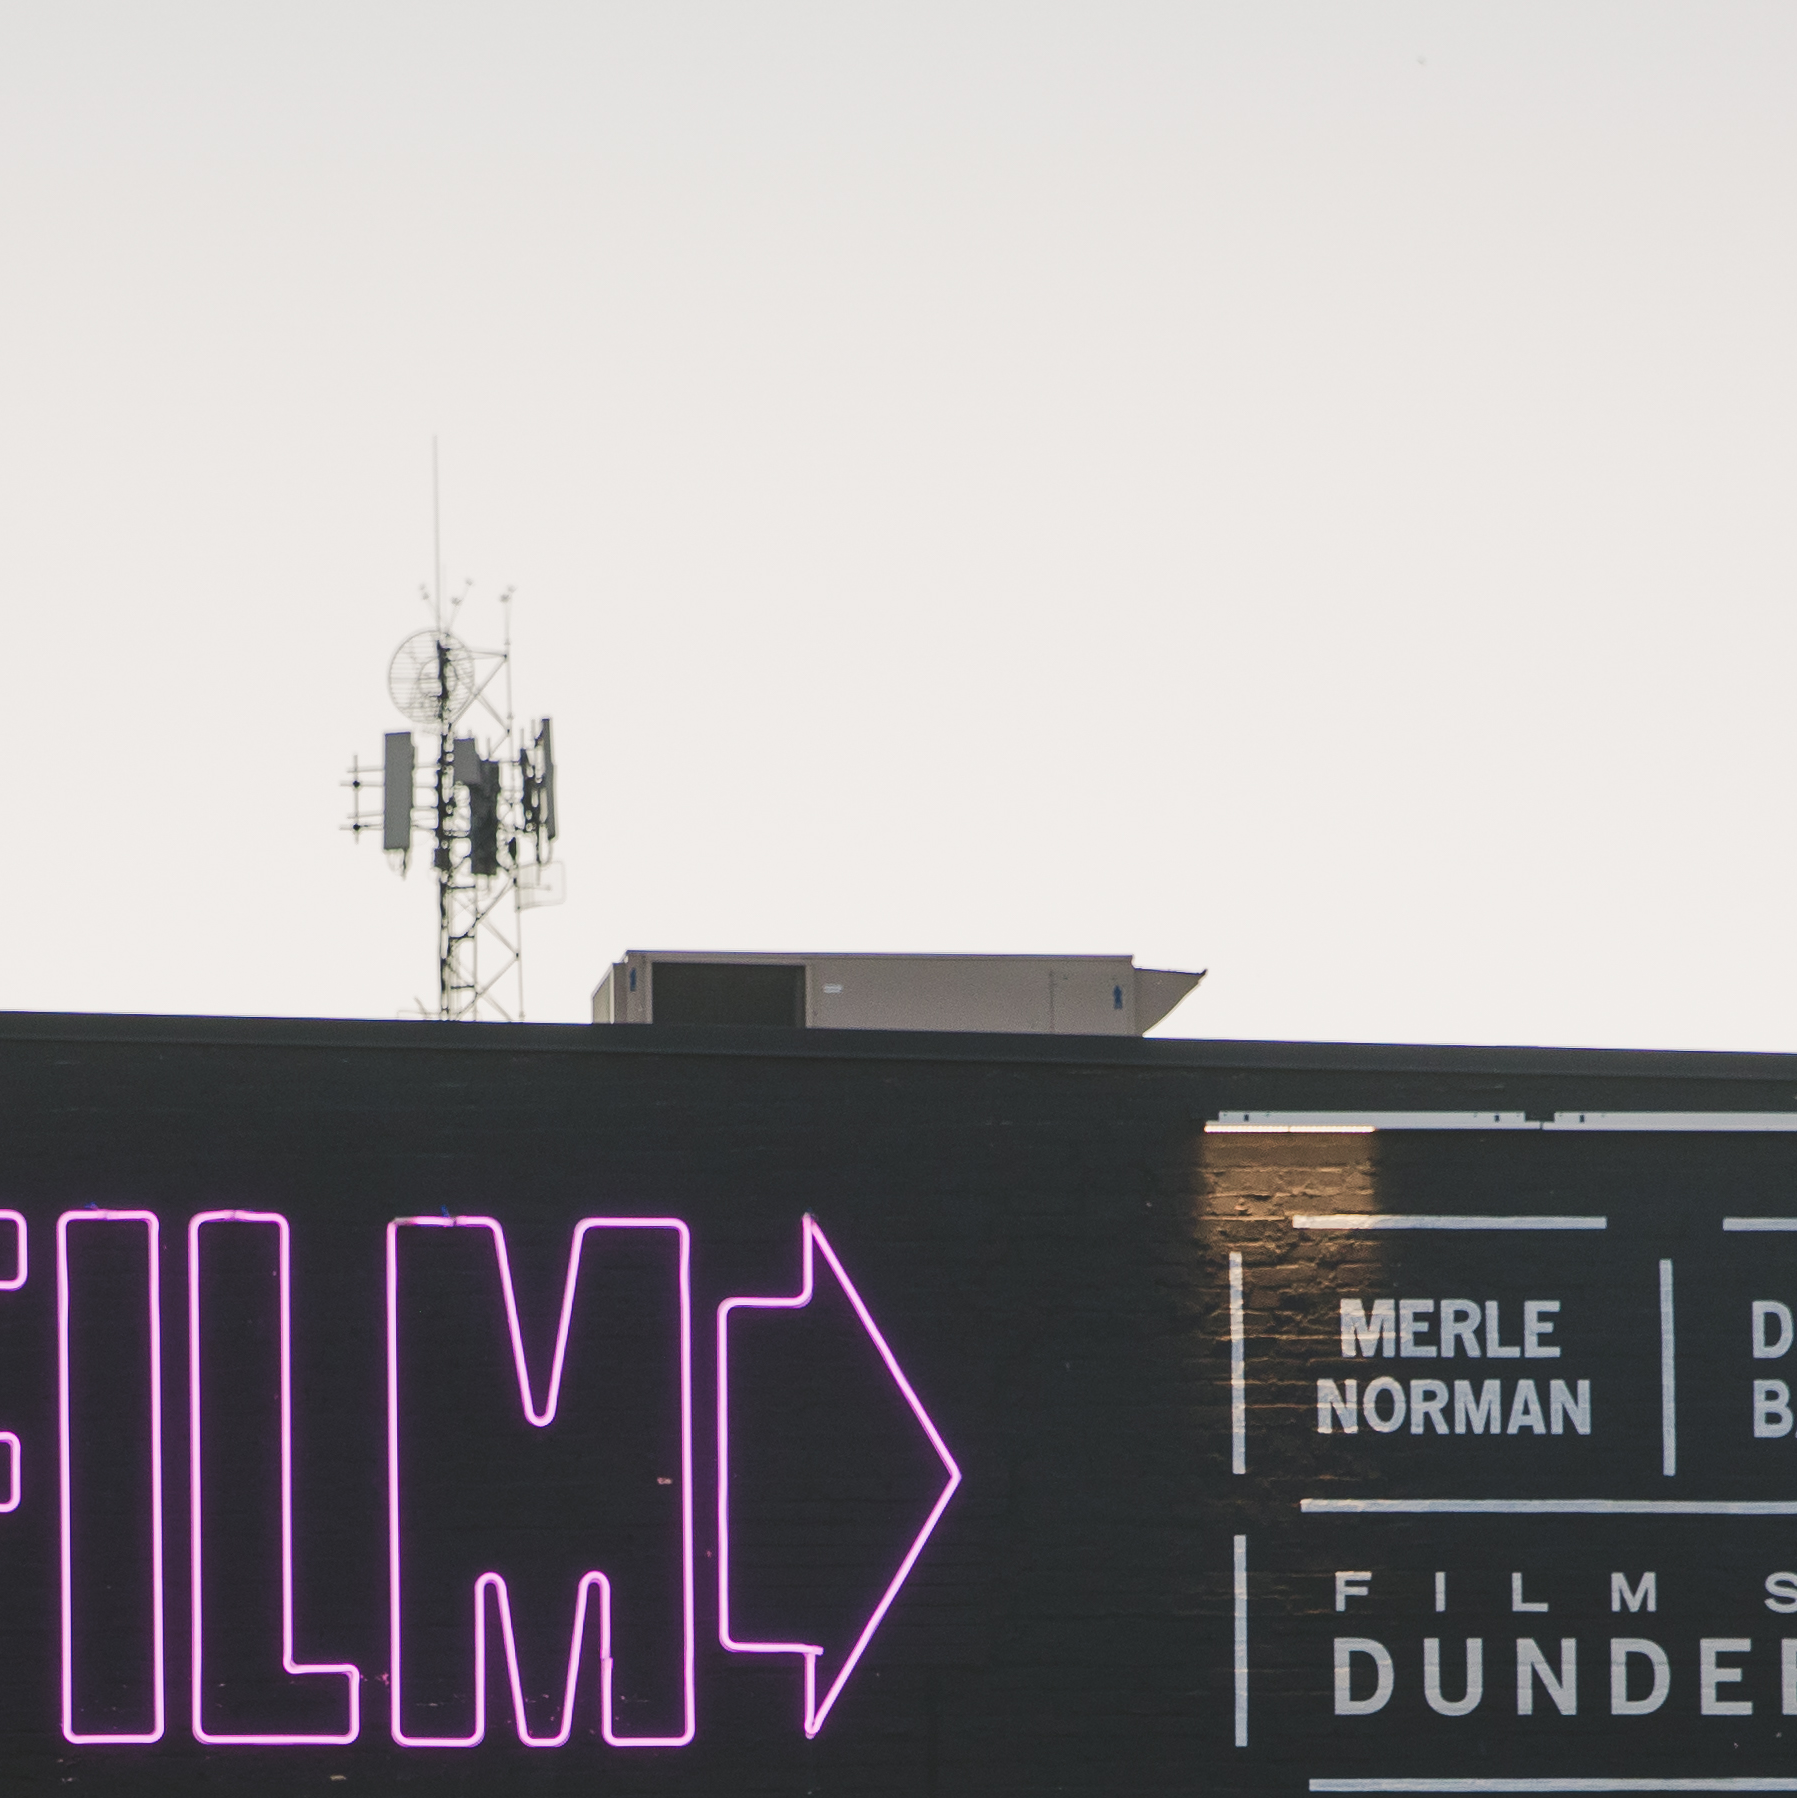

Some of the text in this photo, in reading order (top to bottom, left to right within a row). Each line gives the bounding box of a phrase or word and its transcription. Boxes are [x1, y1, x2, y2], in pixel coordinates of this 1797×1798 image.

[1338, 1297, 1562, 1360] MERLE
[1316, 1375, 1592, 1436] NORMAN
[1334, 1570, 1658, 1613] FILM
